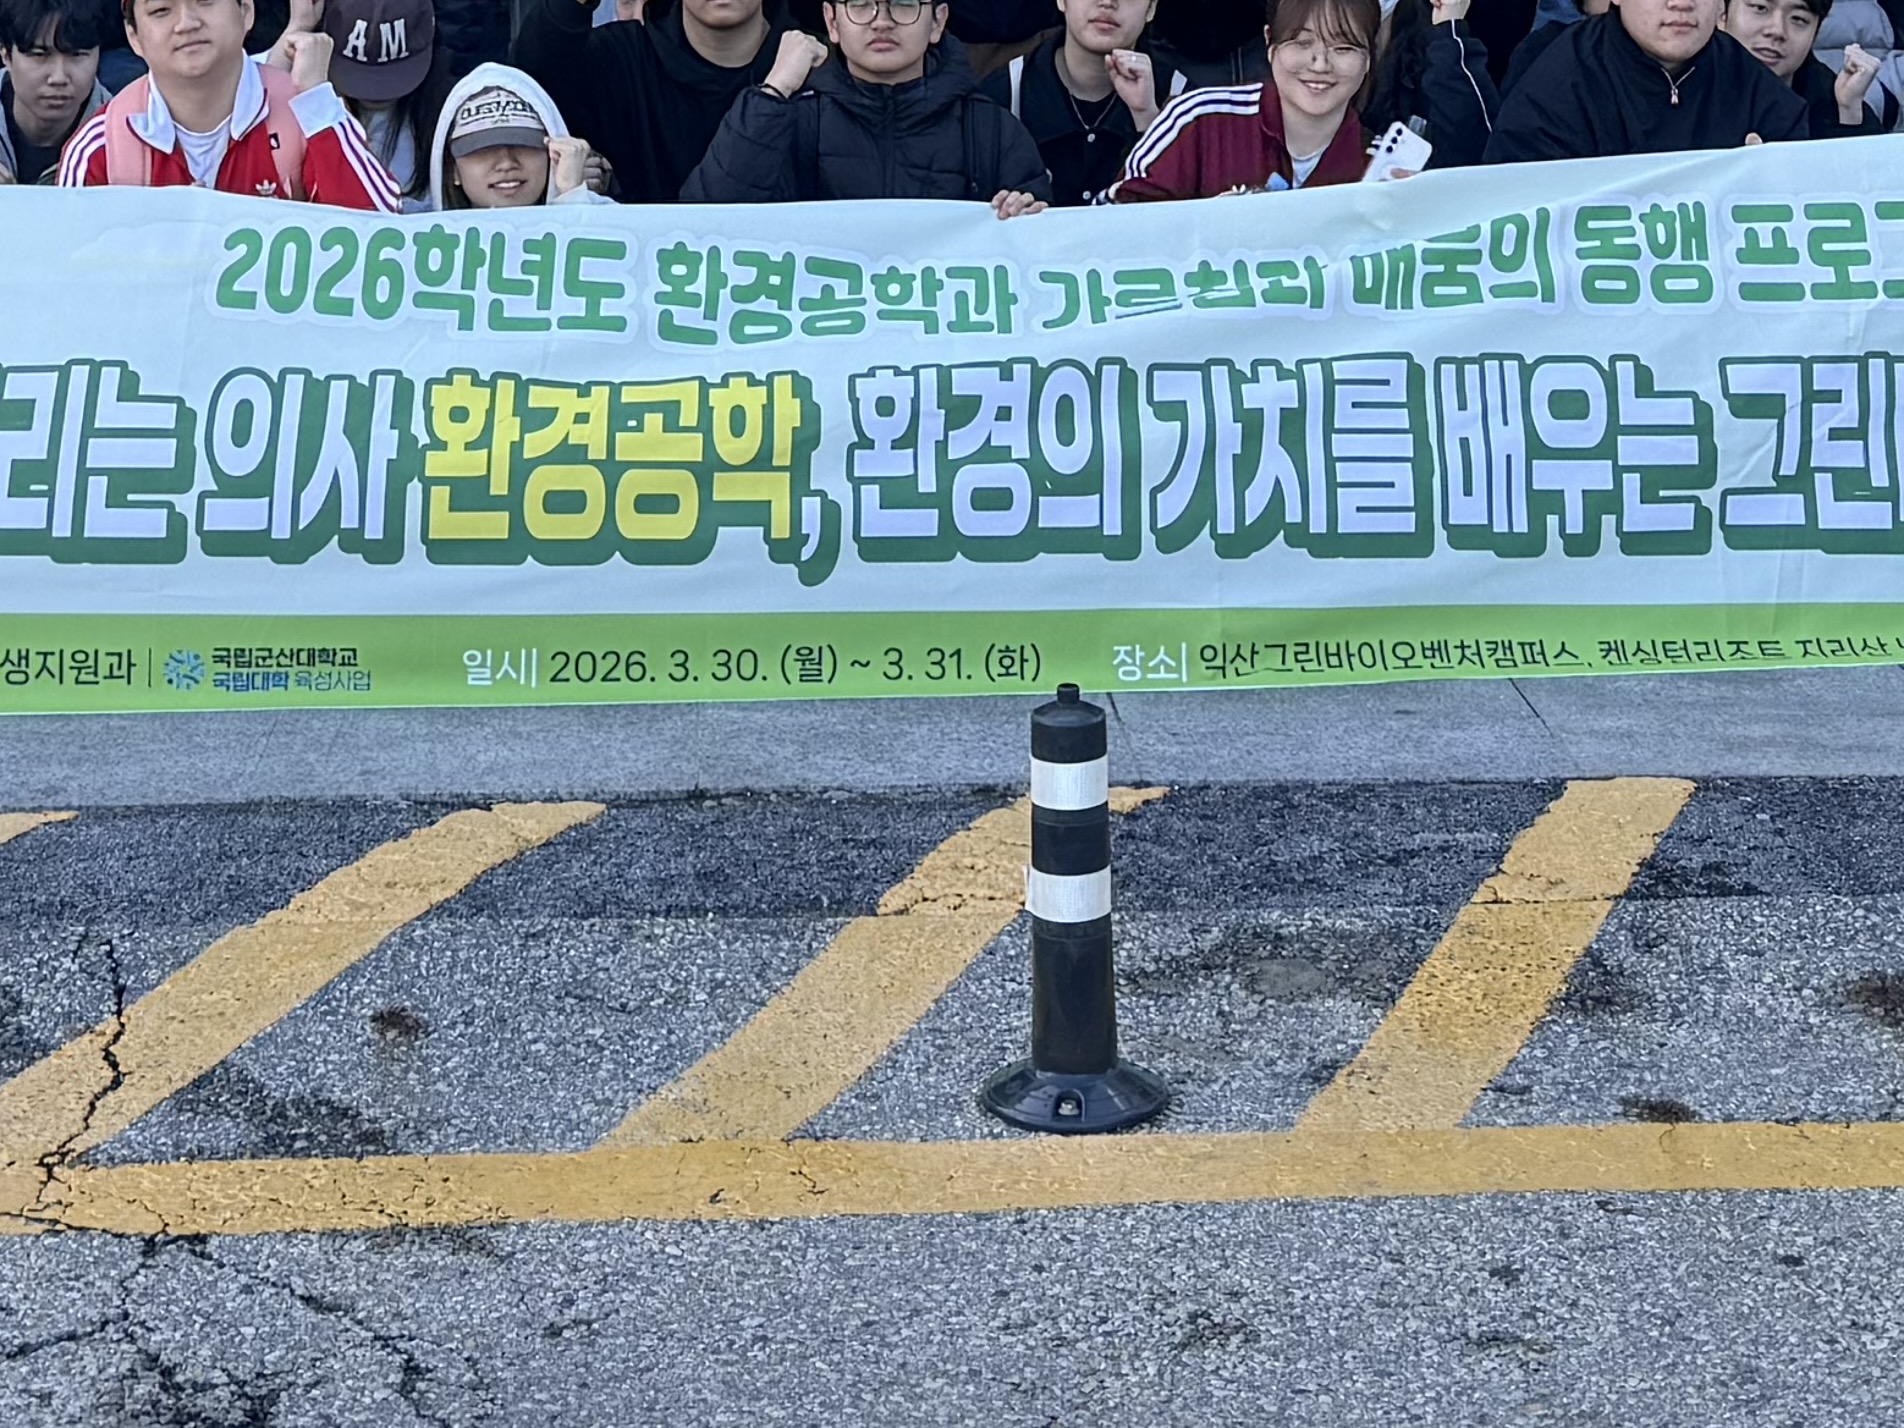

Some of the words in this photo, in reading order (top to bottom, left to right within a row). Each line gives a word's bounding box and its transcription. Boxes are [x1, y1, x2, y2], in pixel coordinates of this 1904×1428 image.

[215, 224, 629, 334] 2026학년도
[654, 241, 1018, 346] 환경공학과
[1351, 206, 1556, 310] 배움의
[1573, 200, 1715, 306] 동행
[201, 366, 412, 554] 의사
[848, 358, 1130, 554] 환경의
[1151, 352, 1428, 552] 가치를
[1435, 352, 1708, 549] 배우는
[210, 647, 359, 669] 국립군산대학교
[548, 650, 657, 684] 2026.
[667, 649, 699, 684] 3.
[710, 648, 768, 683] 30.
[779, 642, 839, 685] (월)
[882, 647, 914, 681] 3.
[924, 646, 974, 681] 31.
[983, 641, 1043, 685] (화)
[210, 670, 289, 692] 국립대학
[293, 669, 372, 692] 육성사업
